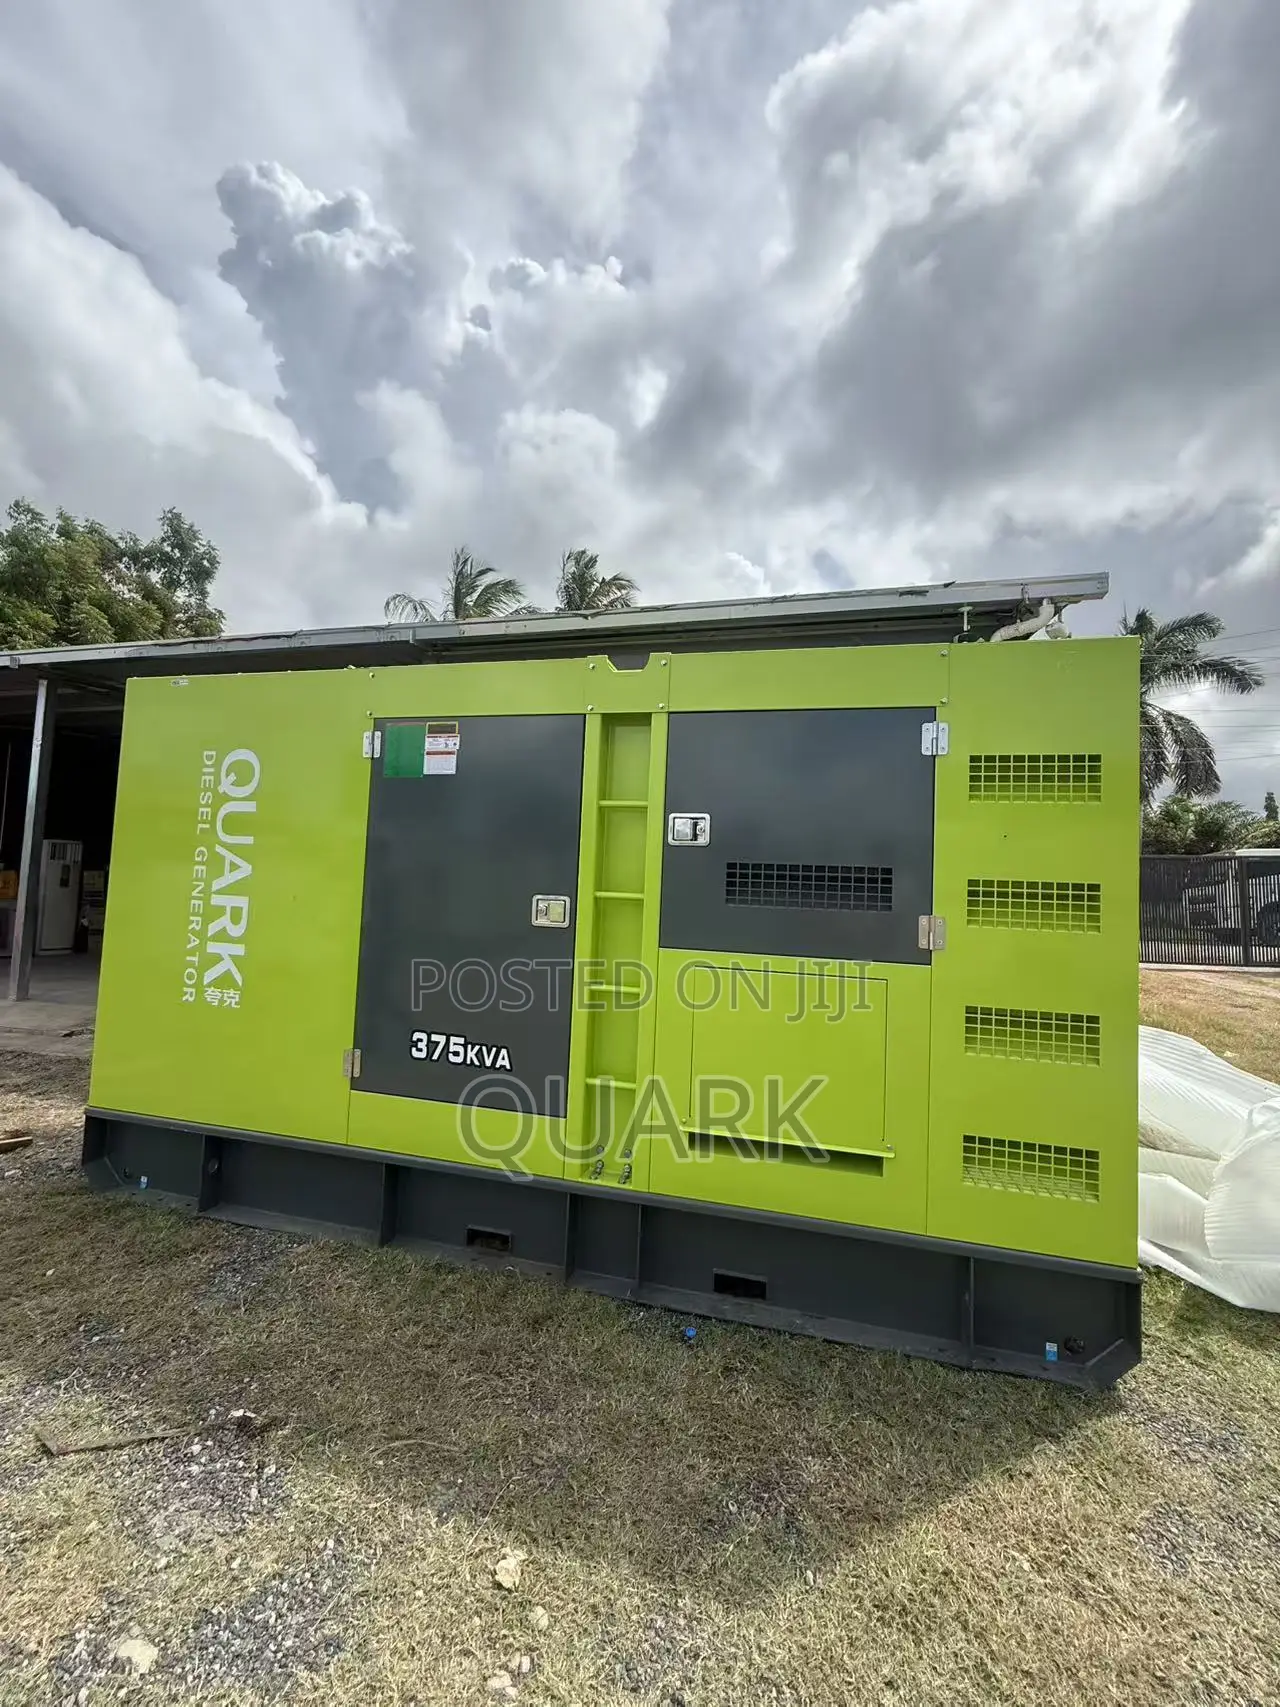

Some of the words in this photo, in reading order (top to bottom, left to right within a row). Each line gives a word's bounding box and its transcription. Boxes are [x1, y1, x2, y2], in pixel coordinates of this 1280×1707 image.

[197, 750, 217, 835] DIESEL
[203, 748, 260, 987] QUARK
[182, 846, 208, 1002] GENERATOR
[203, 987, 241, 1008] 夸克
[410, 1031, 512, 1071] 375KVA
